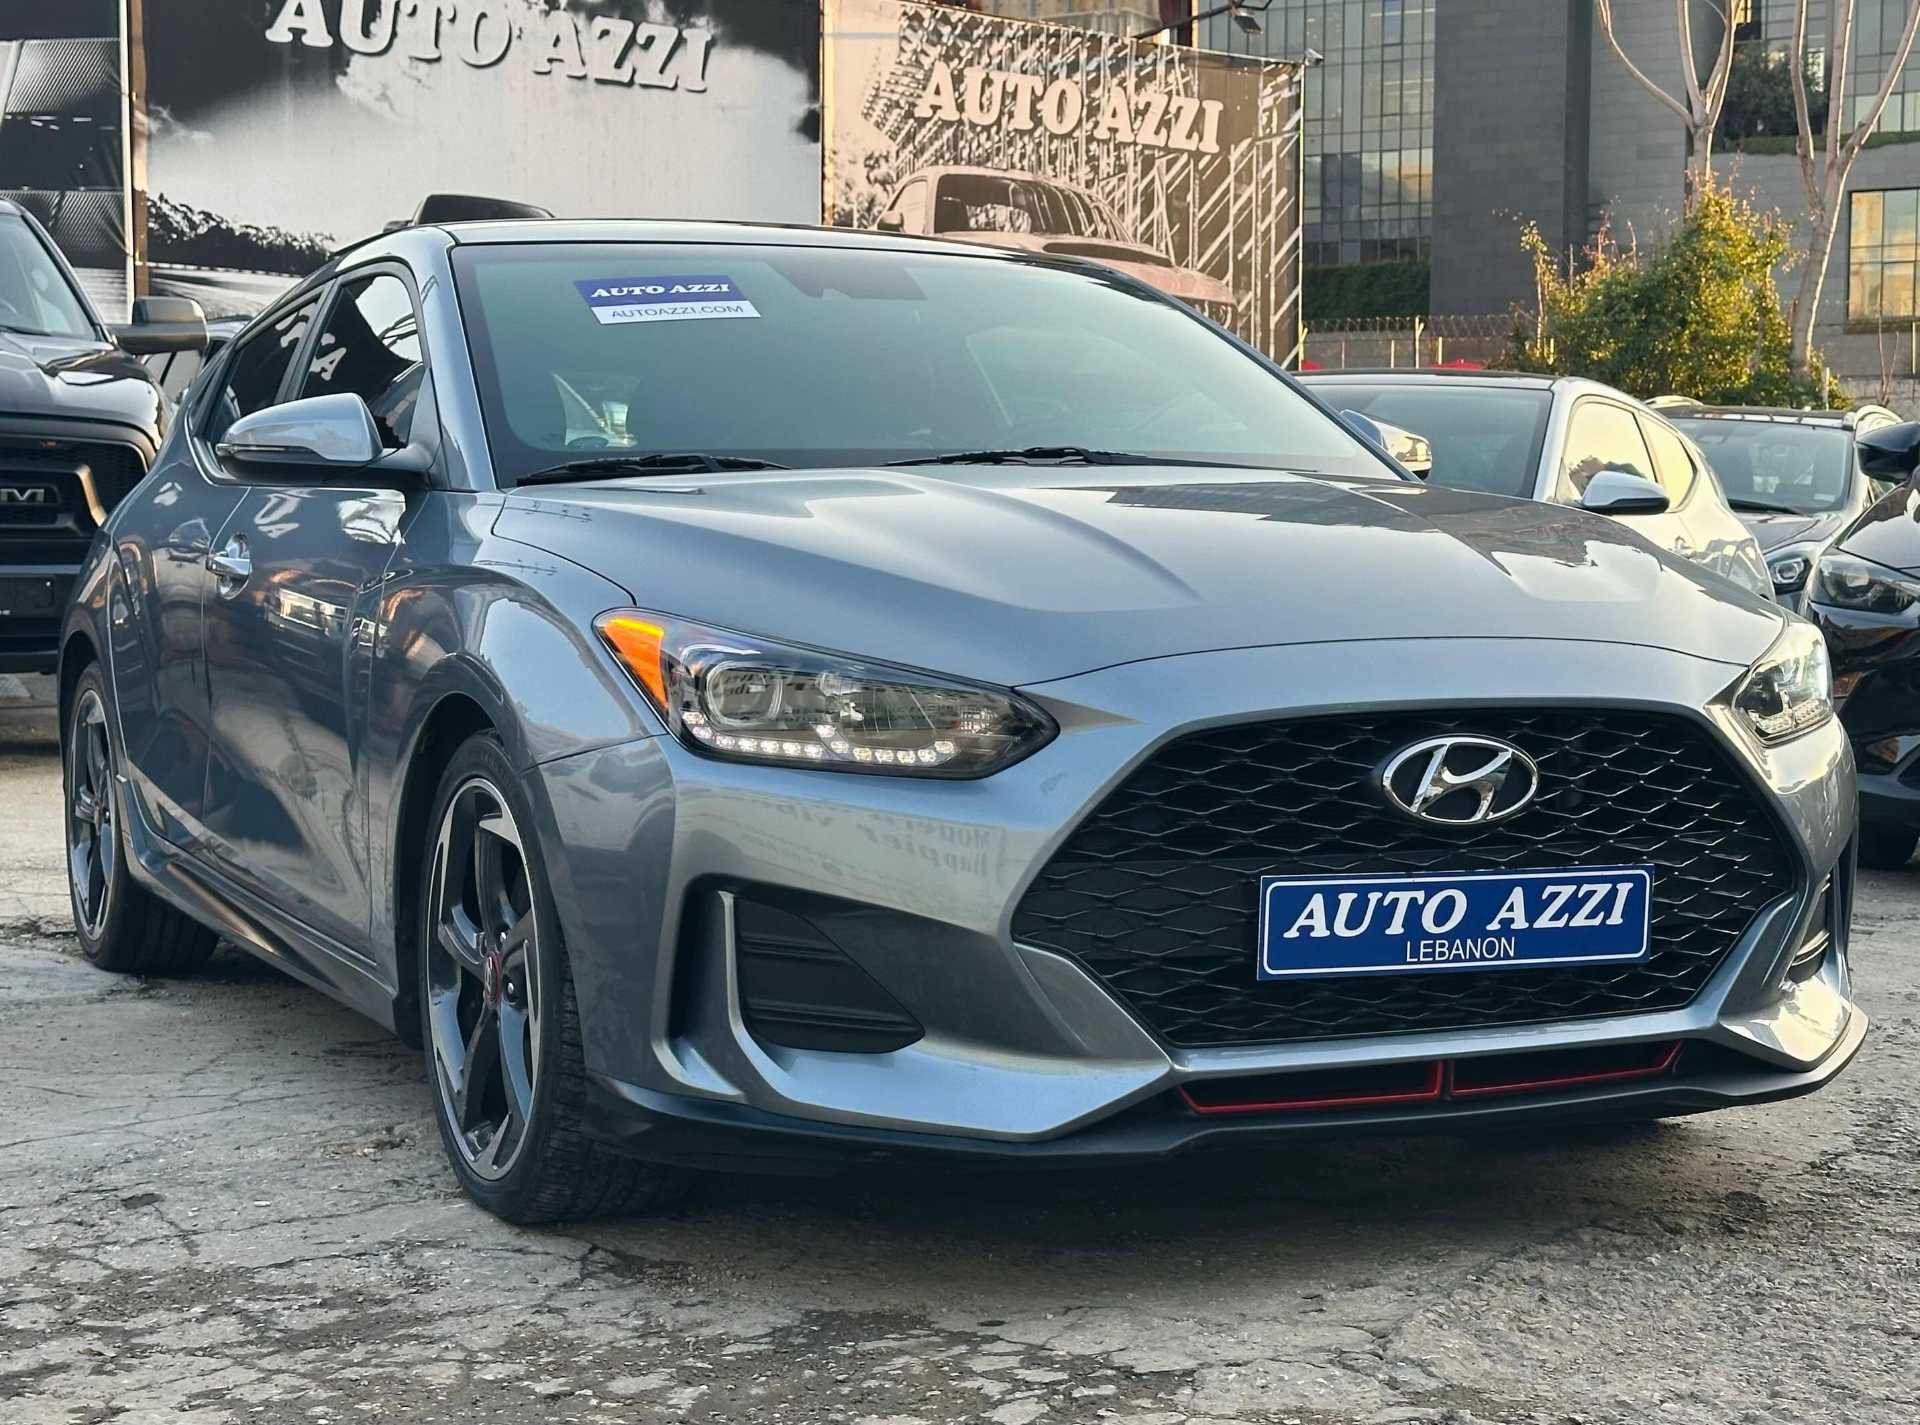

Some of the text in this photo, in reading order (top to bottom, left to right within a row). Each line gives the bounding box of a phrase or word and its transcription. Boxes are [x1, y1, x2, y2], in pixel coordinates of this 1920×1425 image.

[265, 0, 713, 93] AUTO AZZI
[915, 60, 1224, 154] AUTO AZZI
[591, 283, 731, 298] AUTO AZZI
[611, 304, 744, 319] AUTOAZZI.COM
[1283, 882, 1634, 939] AUTO AZZI
[1405, 936, 1516, 963] LEBANON
